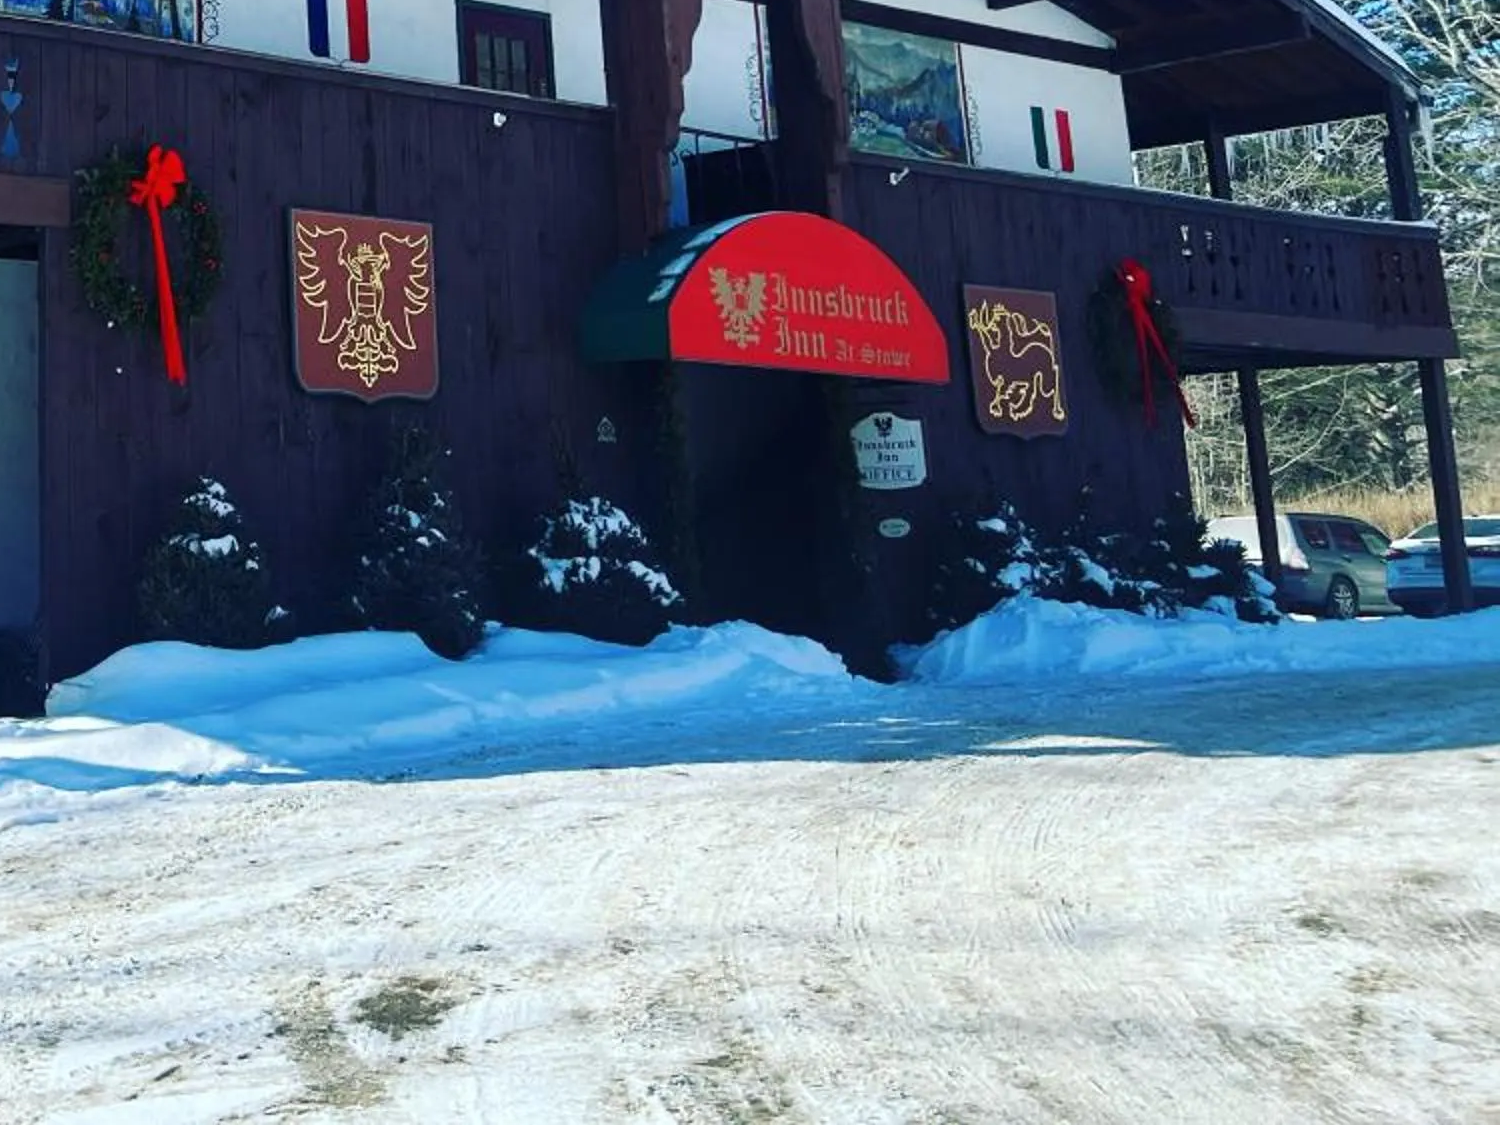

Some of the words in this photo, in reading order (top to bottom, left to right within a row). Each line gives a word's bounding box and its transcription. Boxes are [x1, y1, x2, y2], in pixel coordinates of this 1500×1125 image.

[769, 272, 909, 325] Innsbruck
[773, 315, 827, 360] Inn
[835, 338, 854, 363] At
[860, 342, 911, 369] Stowe
[857, 438, 917, 452] Innsbruck
[876, 451, 899, 465] Inn
